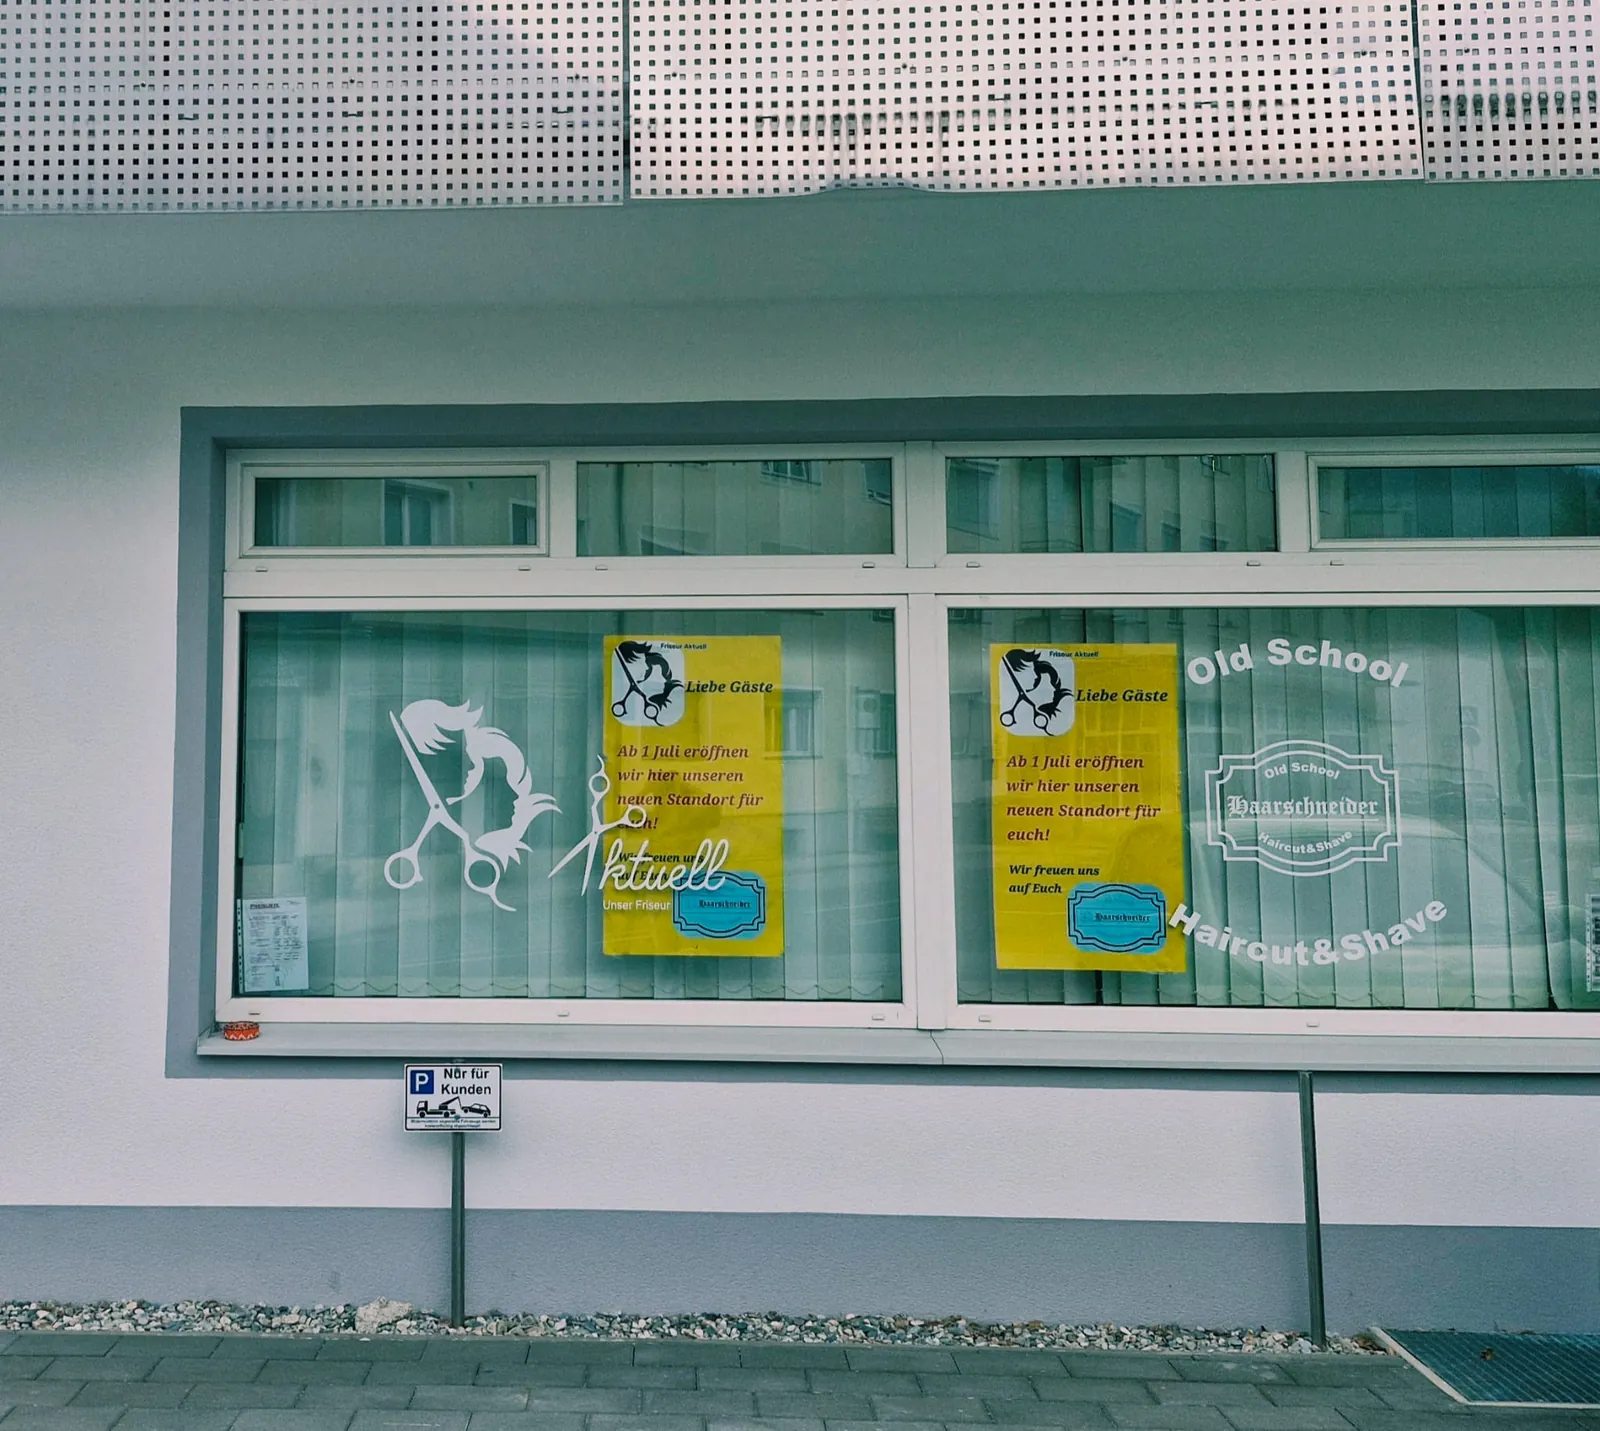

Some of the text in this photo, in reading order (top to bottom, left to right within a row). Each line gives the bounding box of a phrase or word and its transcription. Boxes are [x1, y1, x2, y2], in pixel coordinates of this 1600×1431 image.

[1049, 650, 1073, 658] Friseur
[1187, 638, 1409, 688] Old School
[686, 681, 773, 693] Liebe Gäste
[1076, 689, 1168, 702] Liebe Gäste
[617, 745, 749, 761] Ab 1 Juli eröffnen
[1006, 755, 1144, 772] Ab 1 Juli eröffnen
[618, 769, 744, 782] wir hier unseren
[1264, 762, 1340, 780] Old School
[1006, 779, 1139, 793] wir hier unseren
[617, 793, 763, 809] neuen Standort für
[1226, 795, 1379, 818] Haarschneider
[1006, 804, 1161, 820] neuen Standort für
[1007, 828, 1051, 841] euch!
[1258, 831, 1353, 854] Haircut&Shave
[1009, 865, 1099, 877] Wir freuen uns
[1009, 883, 1062, 895] auf Euch
[603, 900, 672, 911] Unser Friseur
[1168, 900, 1447, 966] Haircut&Shave
[444, 1068, 489, 1079] Nur für
[415, 1072, 429, 1092] P
[441, 1084, 491, 1095] Kunden
